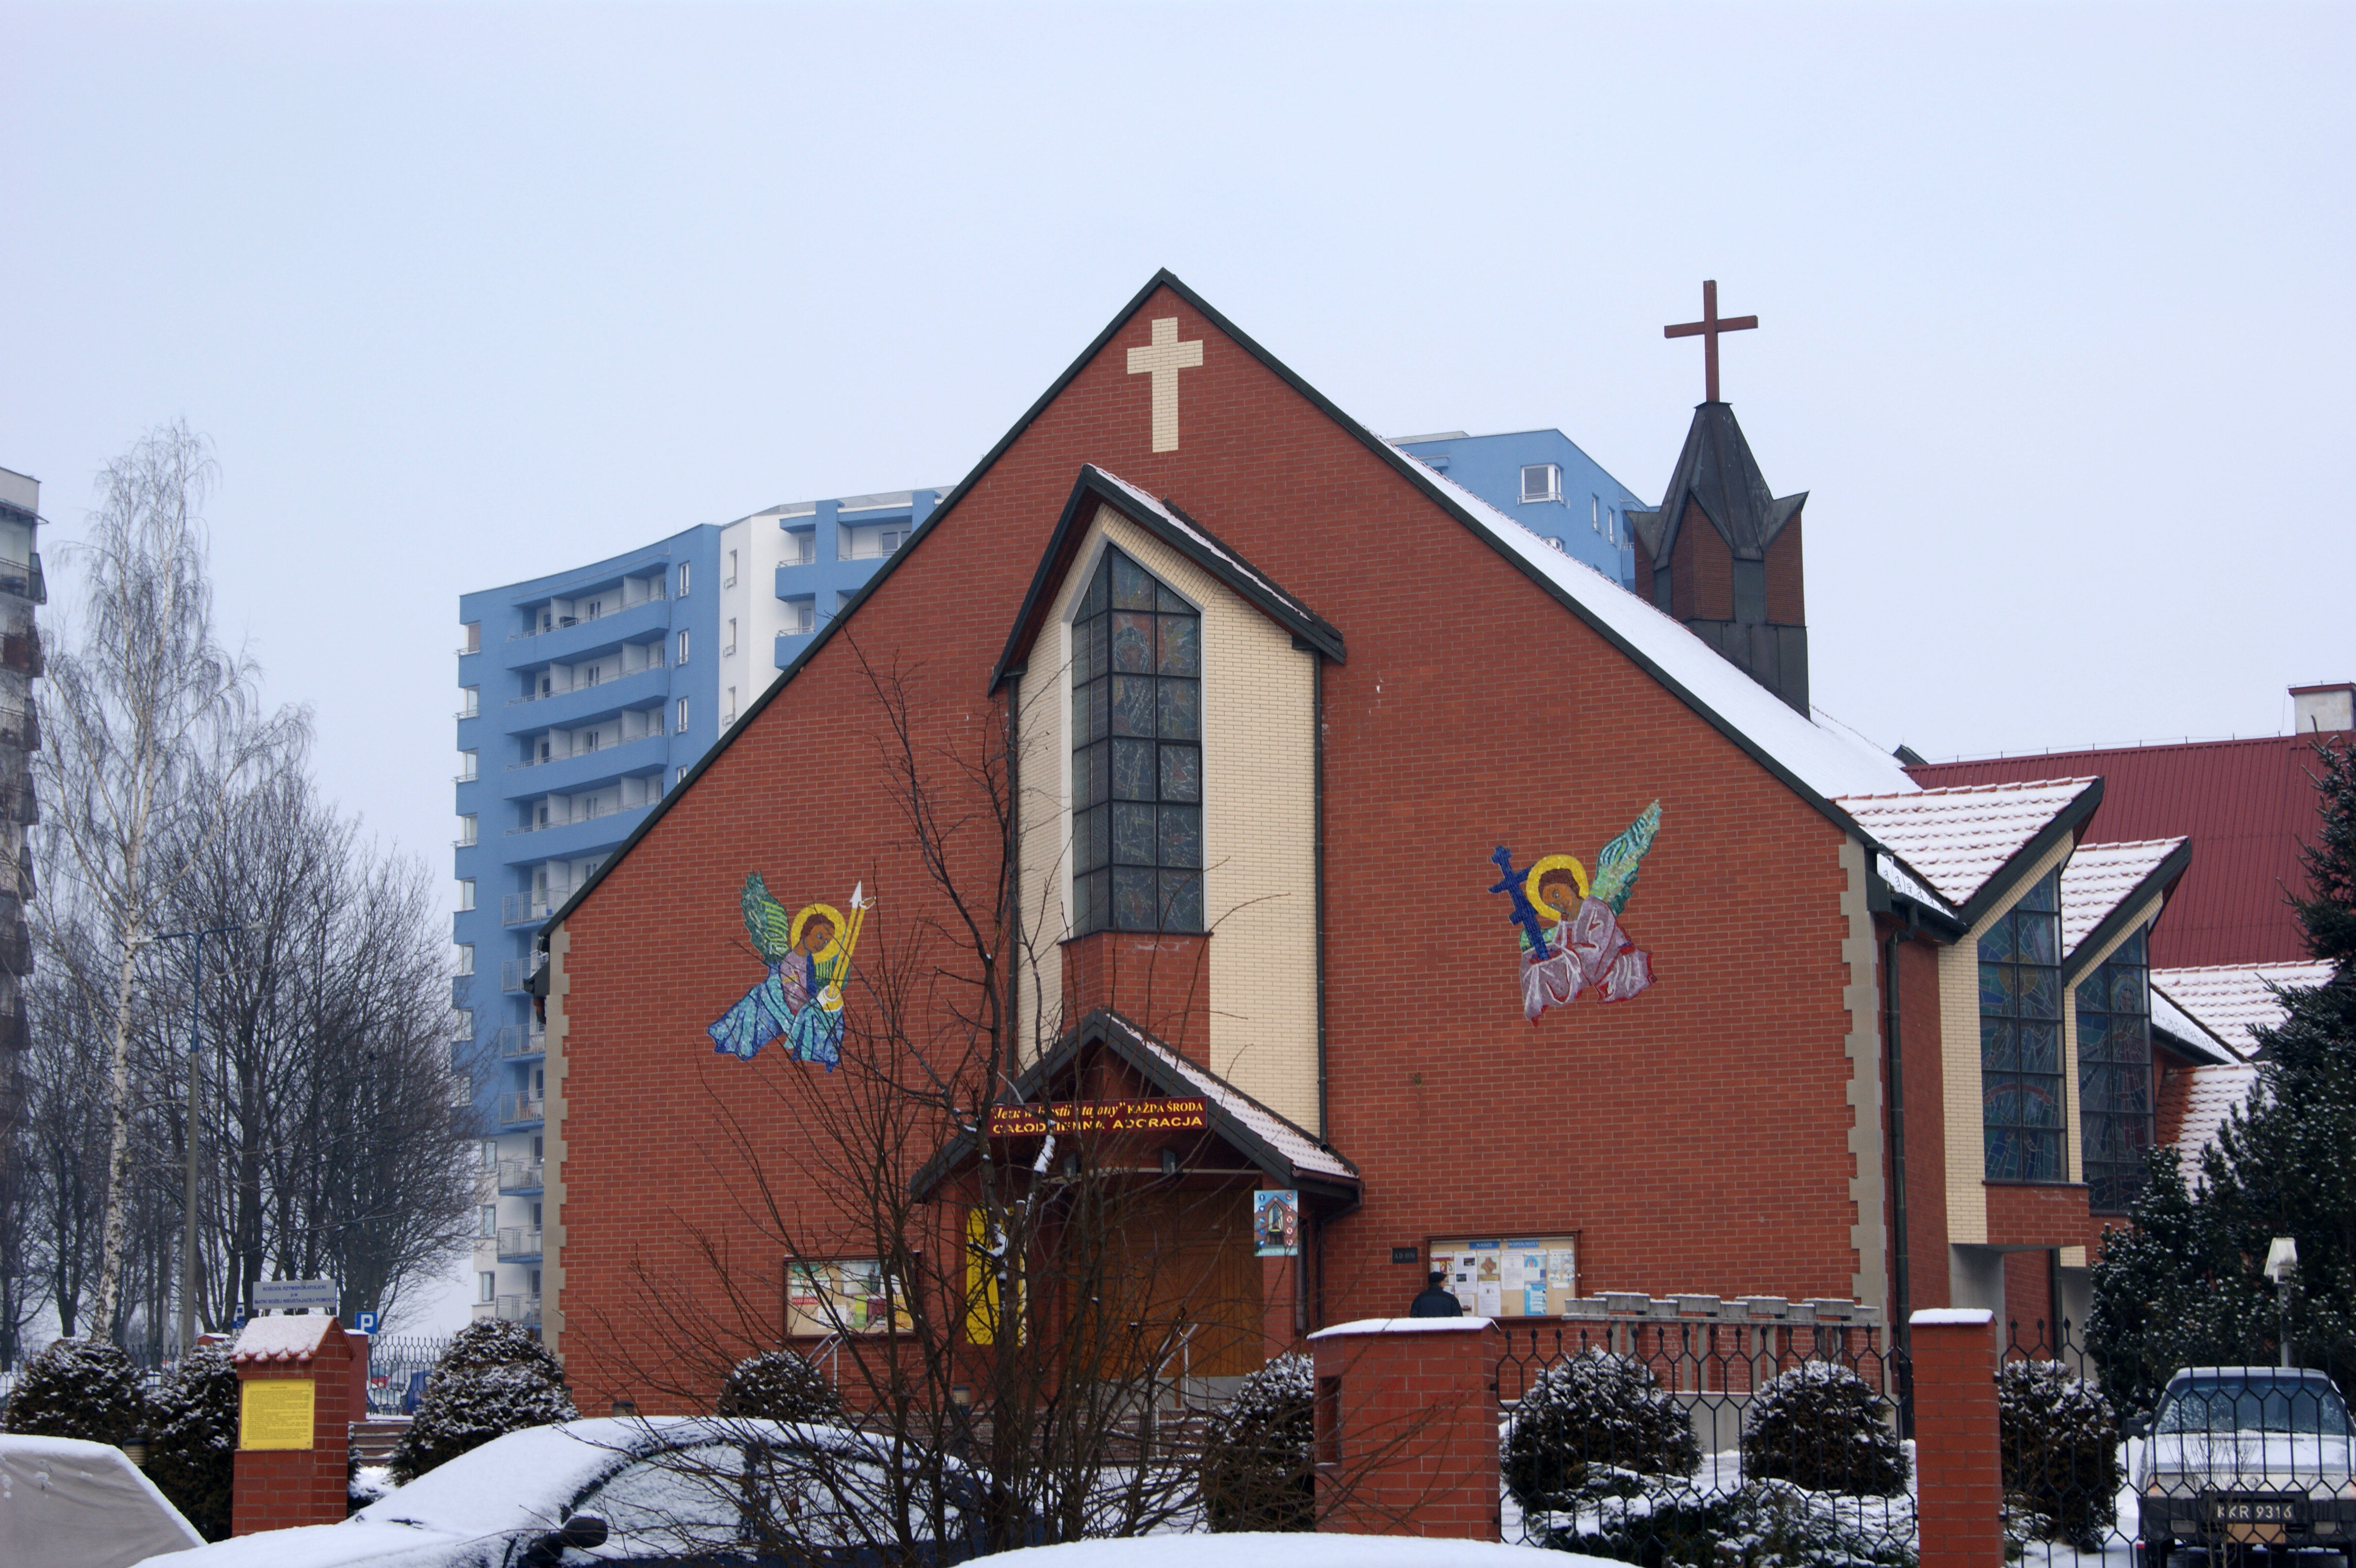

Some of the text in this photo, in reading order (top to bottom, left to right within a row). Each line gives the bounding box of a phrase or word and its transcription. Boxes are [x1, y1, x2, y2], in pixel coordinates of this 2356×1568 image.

[1037, 1104, 1072, 1118] Hstii
[1127, 1102, 1165, 1114] KAŻDA
[1167, 1100, 1203, 1112] ŚRODA
[993, 1116, 1203, 1134] CAŁODIENNA ADORACJA
[361, 1314, 374, 1332] P
[2217, 1505, 2291, 1519] KKR 9316
